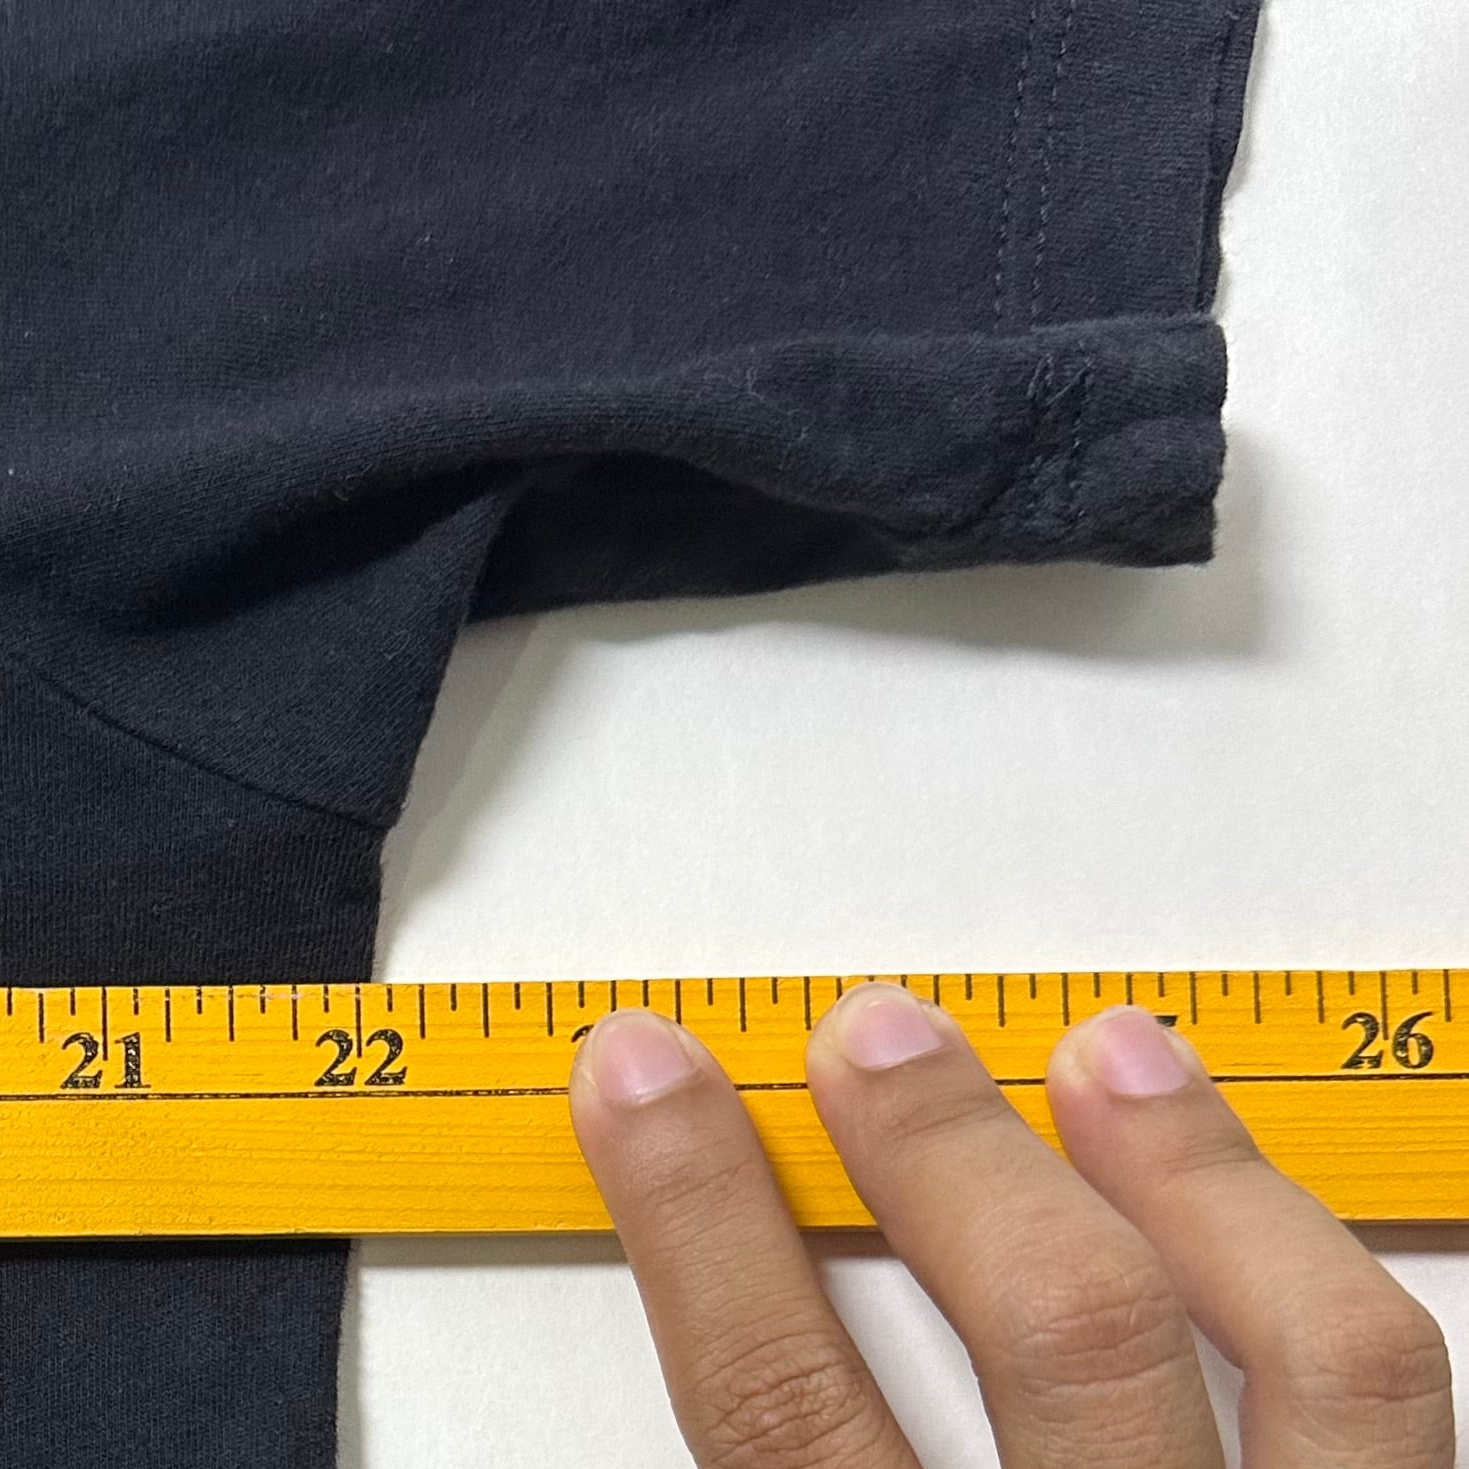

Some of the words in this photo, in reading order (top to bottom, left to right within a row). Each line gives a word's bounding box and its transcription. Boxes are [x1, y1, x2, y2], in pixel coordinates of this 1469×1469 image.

[60, 1032, 151, 1090] 21
[314, 1029, 408, 1087] 22
[1341, 1011, 1435, 1070] 26
